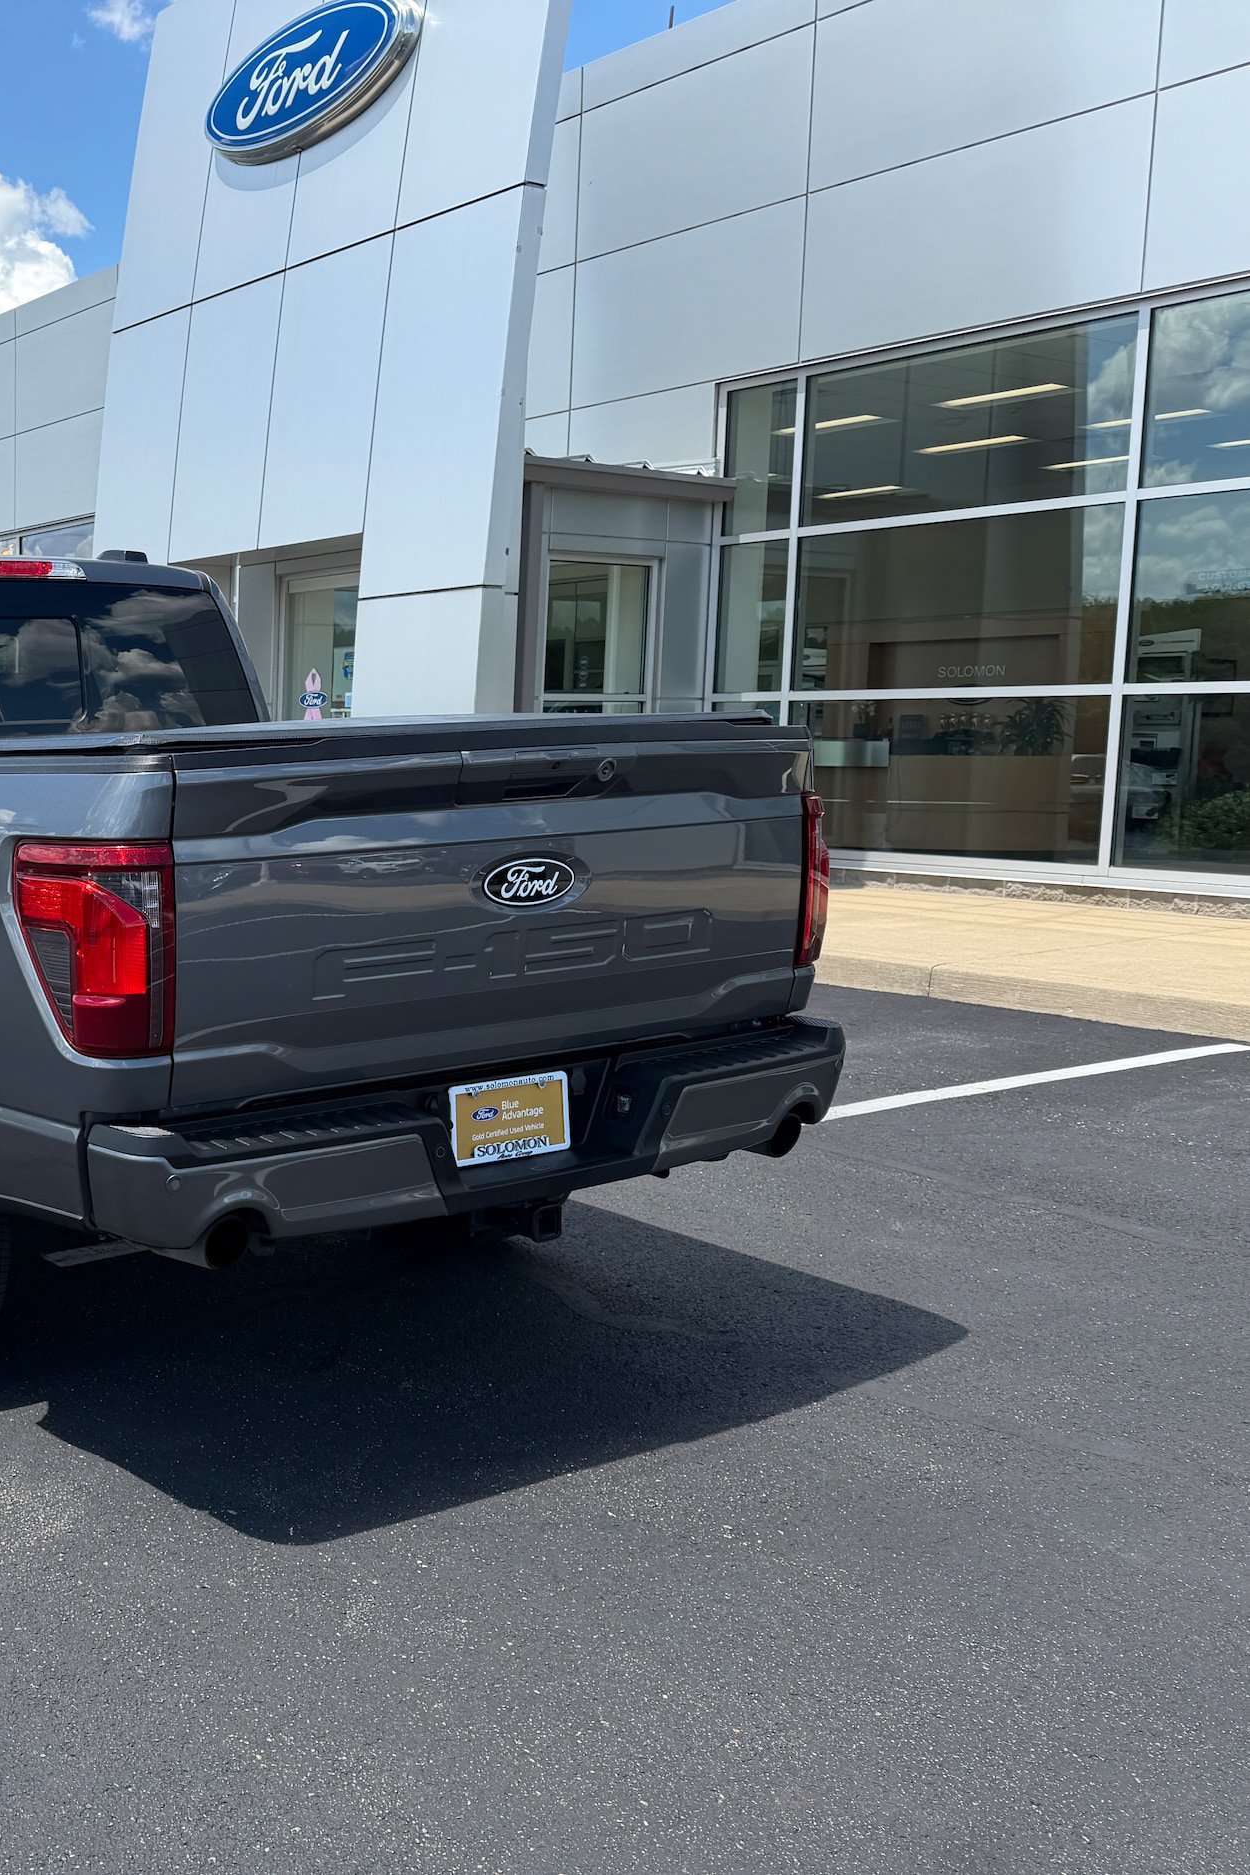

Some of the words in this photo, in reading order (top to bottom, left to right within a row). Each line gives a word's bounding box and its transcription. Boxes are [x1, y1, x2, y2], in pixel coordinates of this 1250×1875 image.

[236, 29, 350, 131] Ford
[937, 664, 1006, 678] SOLOMON
[303, 693, 323, 706] Ford
[499, 865, 560, 899] Ford
[312, 907, 713, 1001] F-150
[464, 1074, 555, 1092] www.solomonauto.com
[476, 1108, 495, 1120] Ford
[501, 1100, 519, 1111] Blue
[501, 1106, 544, 1121] Advantage
[471, 1132, 485, 1142] Gold
[485, 1127, 509, 1139] Certified
[509, 1125, 524, 1135] Used
[525, 1122, 545, 1132] Vehicle
[476, 1136, 548, 1158] SOLOMON
